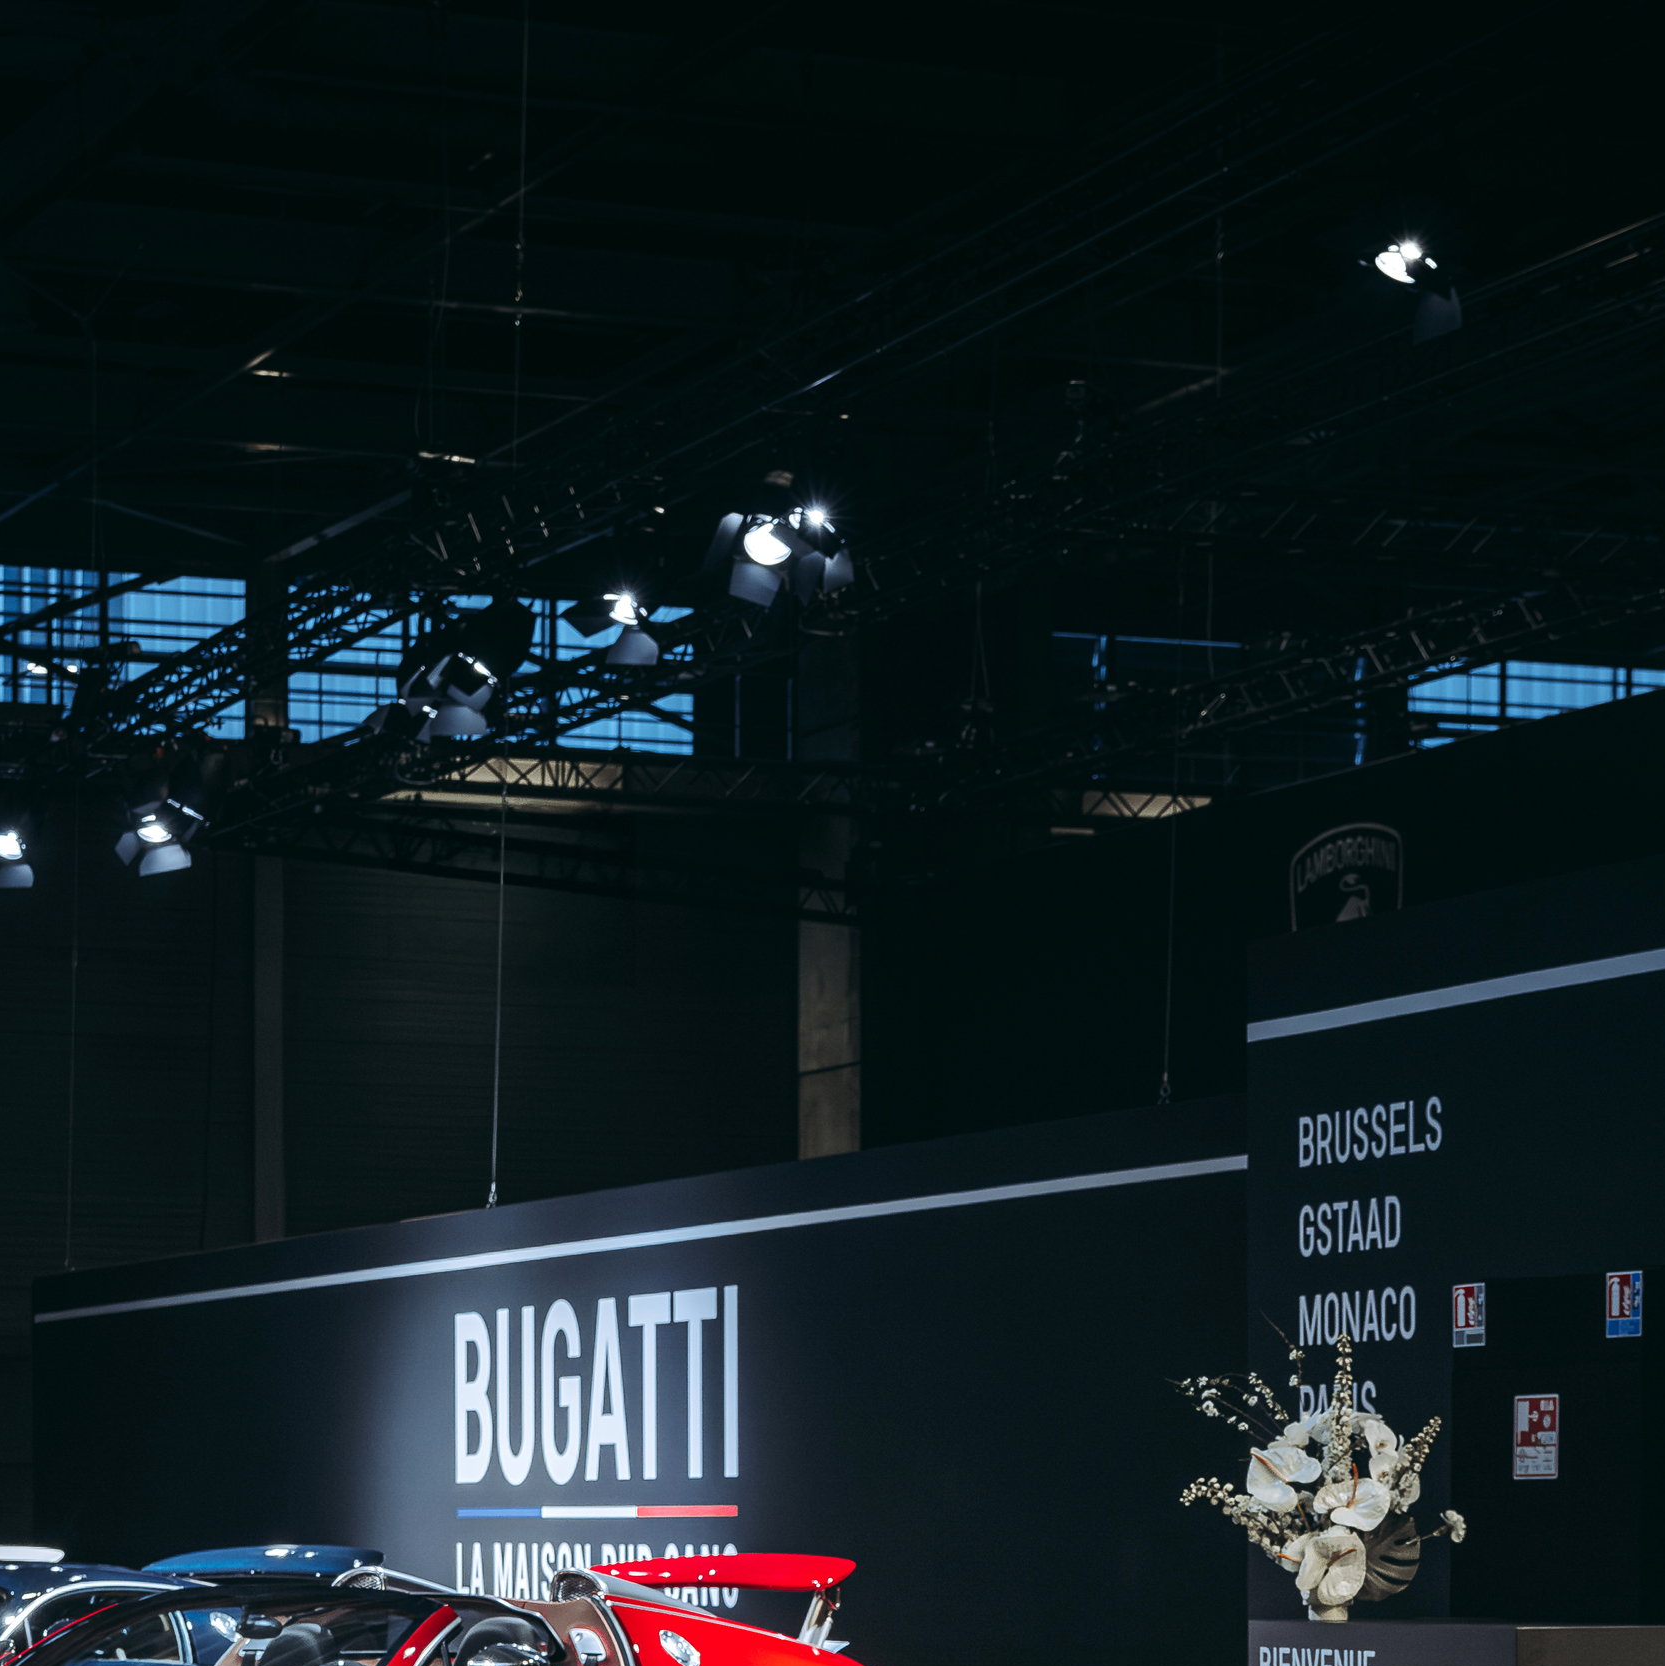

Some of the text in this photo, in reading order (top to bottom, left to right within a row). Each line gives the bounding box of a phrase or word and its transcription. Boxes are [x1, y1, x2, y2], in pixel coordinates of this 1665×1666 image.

[1298, 1097, 1443, 1168] BRUSSELS
[1298, 1195, 1402, 1258] GSTAAD
[1298, 1285, 1417, 1348] MONACO
[454, 1284, 739, 1486] BUGATTI
[1299, 1380, 1377, 1423] PAIS
[455, 1542, 485, 1597] LA
